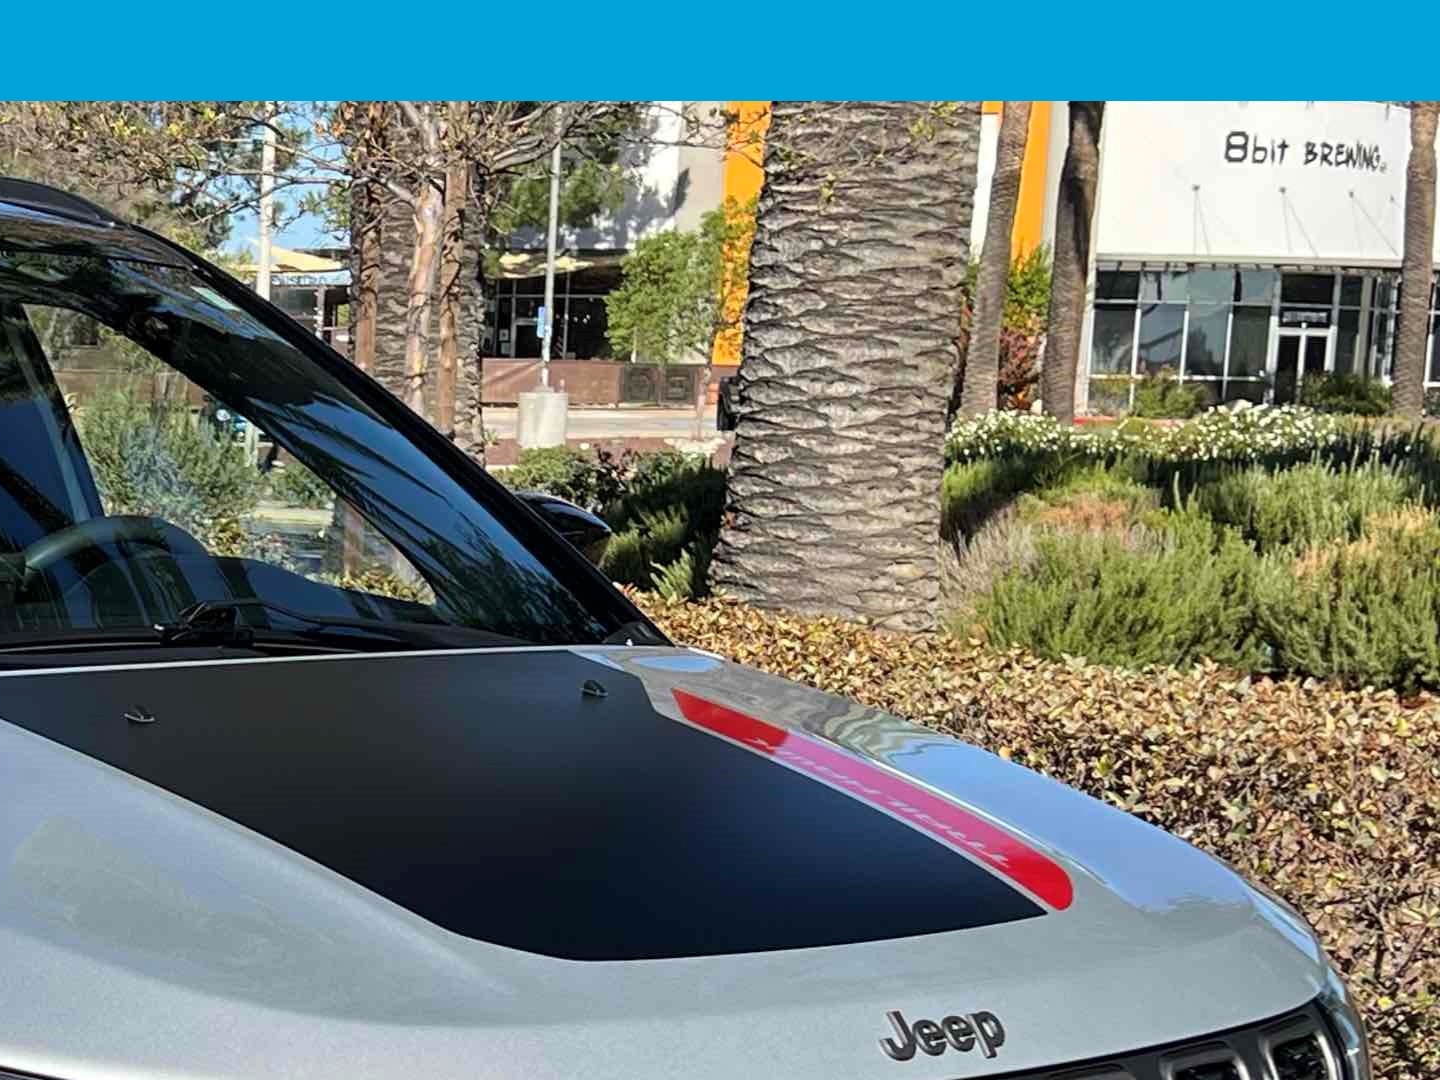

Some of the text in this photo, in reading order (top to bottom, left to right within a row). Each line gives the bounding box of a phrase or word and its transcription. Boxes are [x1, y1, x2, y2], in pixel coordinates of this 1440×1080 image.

[1224, 131, 1381, 171] 8bit BREWING
[879, 1010, 1006, 1061] Jeep
